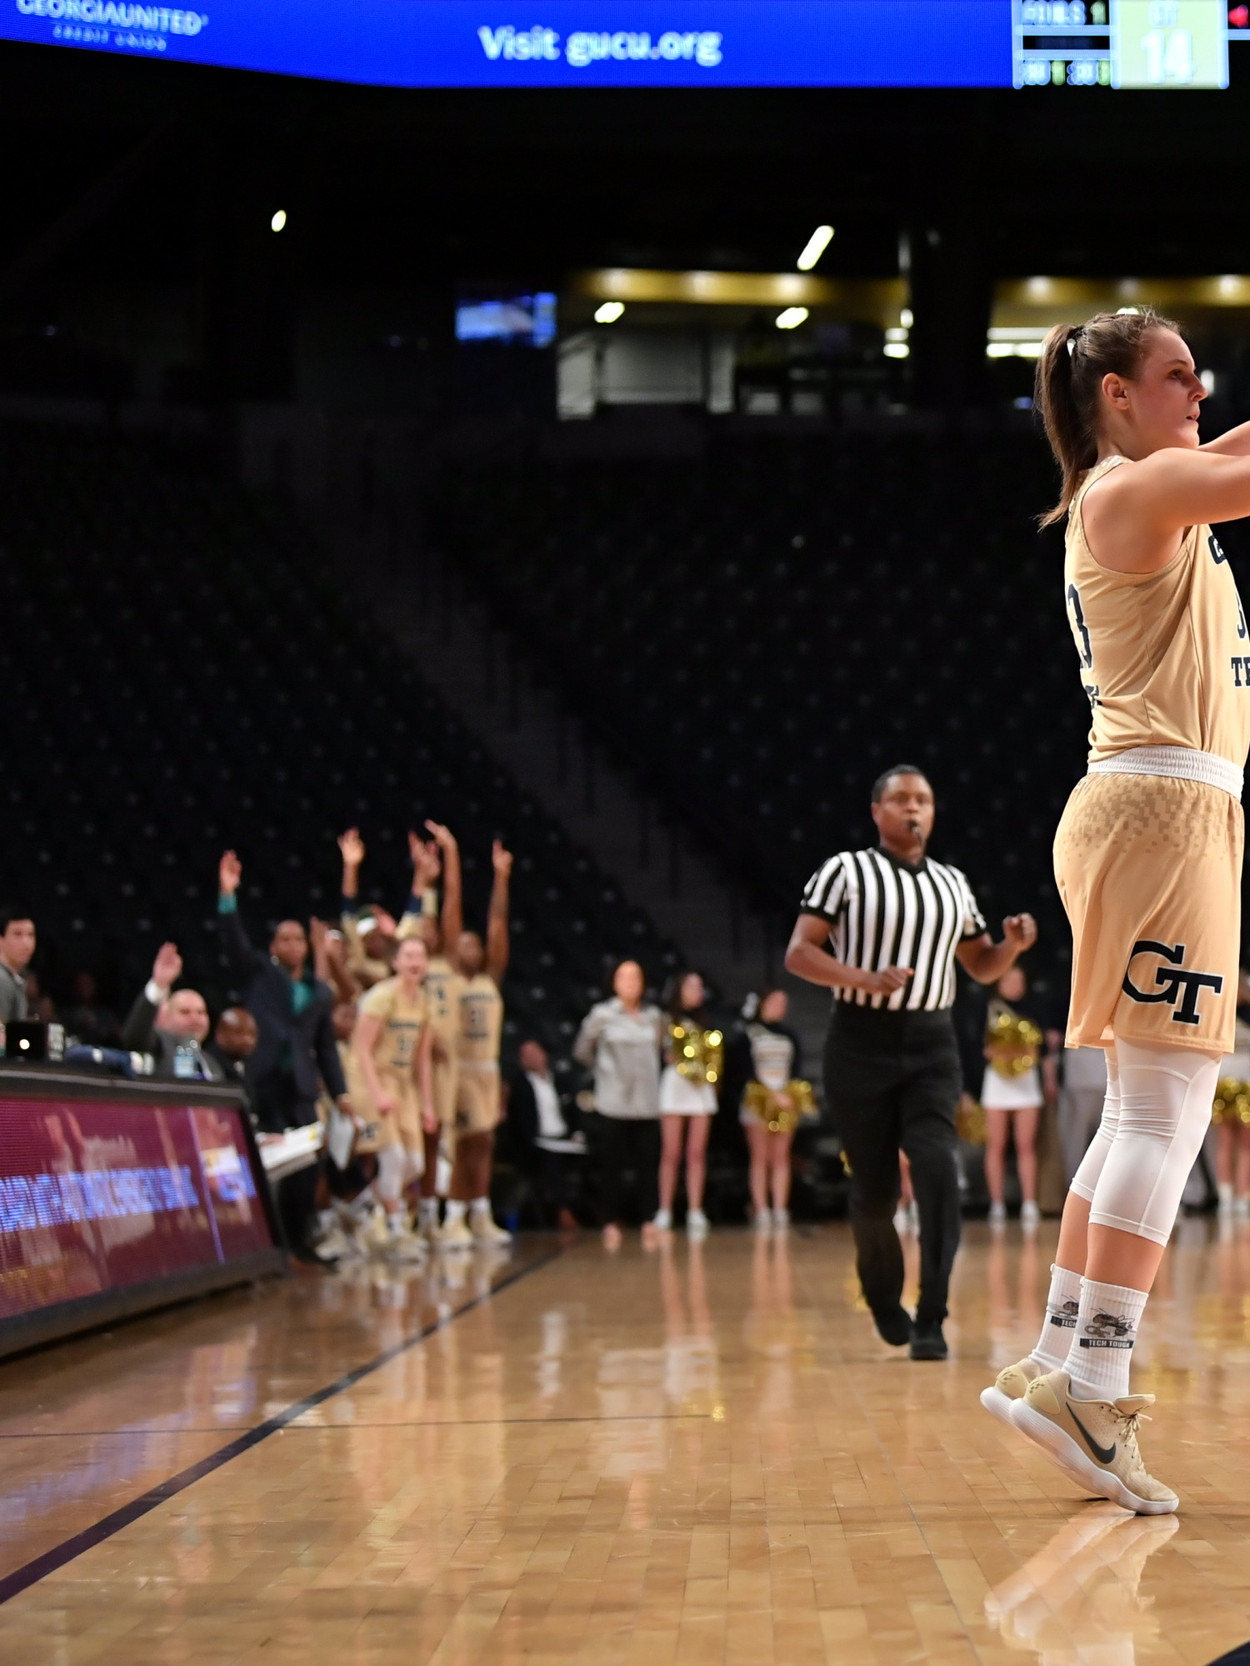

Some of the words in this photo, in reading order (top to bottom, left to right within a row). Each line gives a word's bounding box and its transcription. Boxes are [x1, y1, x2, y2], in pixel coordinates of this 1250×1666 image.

[477, 25, 560, 60] Visit
[566, 31, 723, 67] gucu.org
[1141, 28, 1195, 84] 14
[1121, 939, 1224, 1026] GT
[1088, 1339, 1107, 1347] TECH
